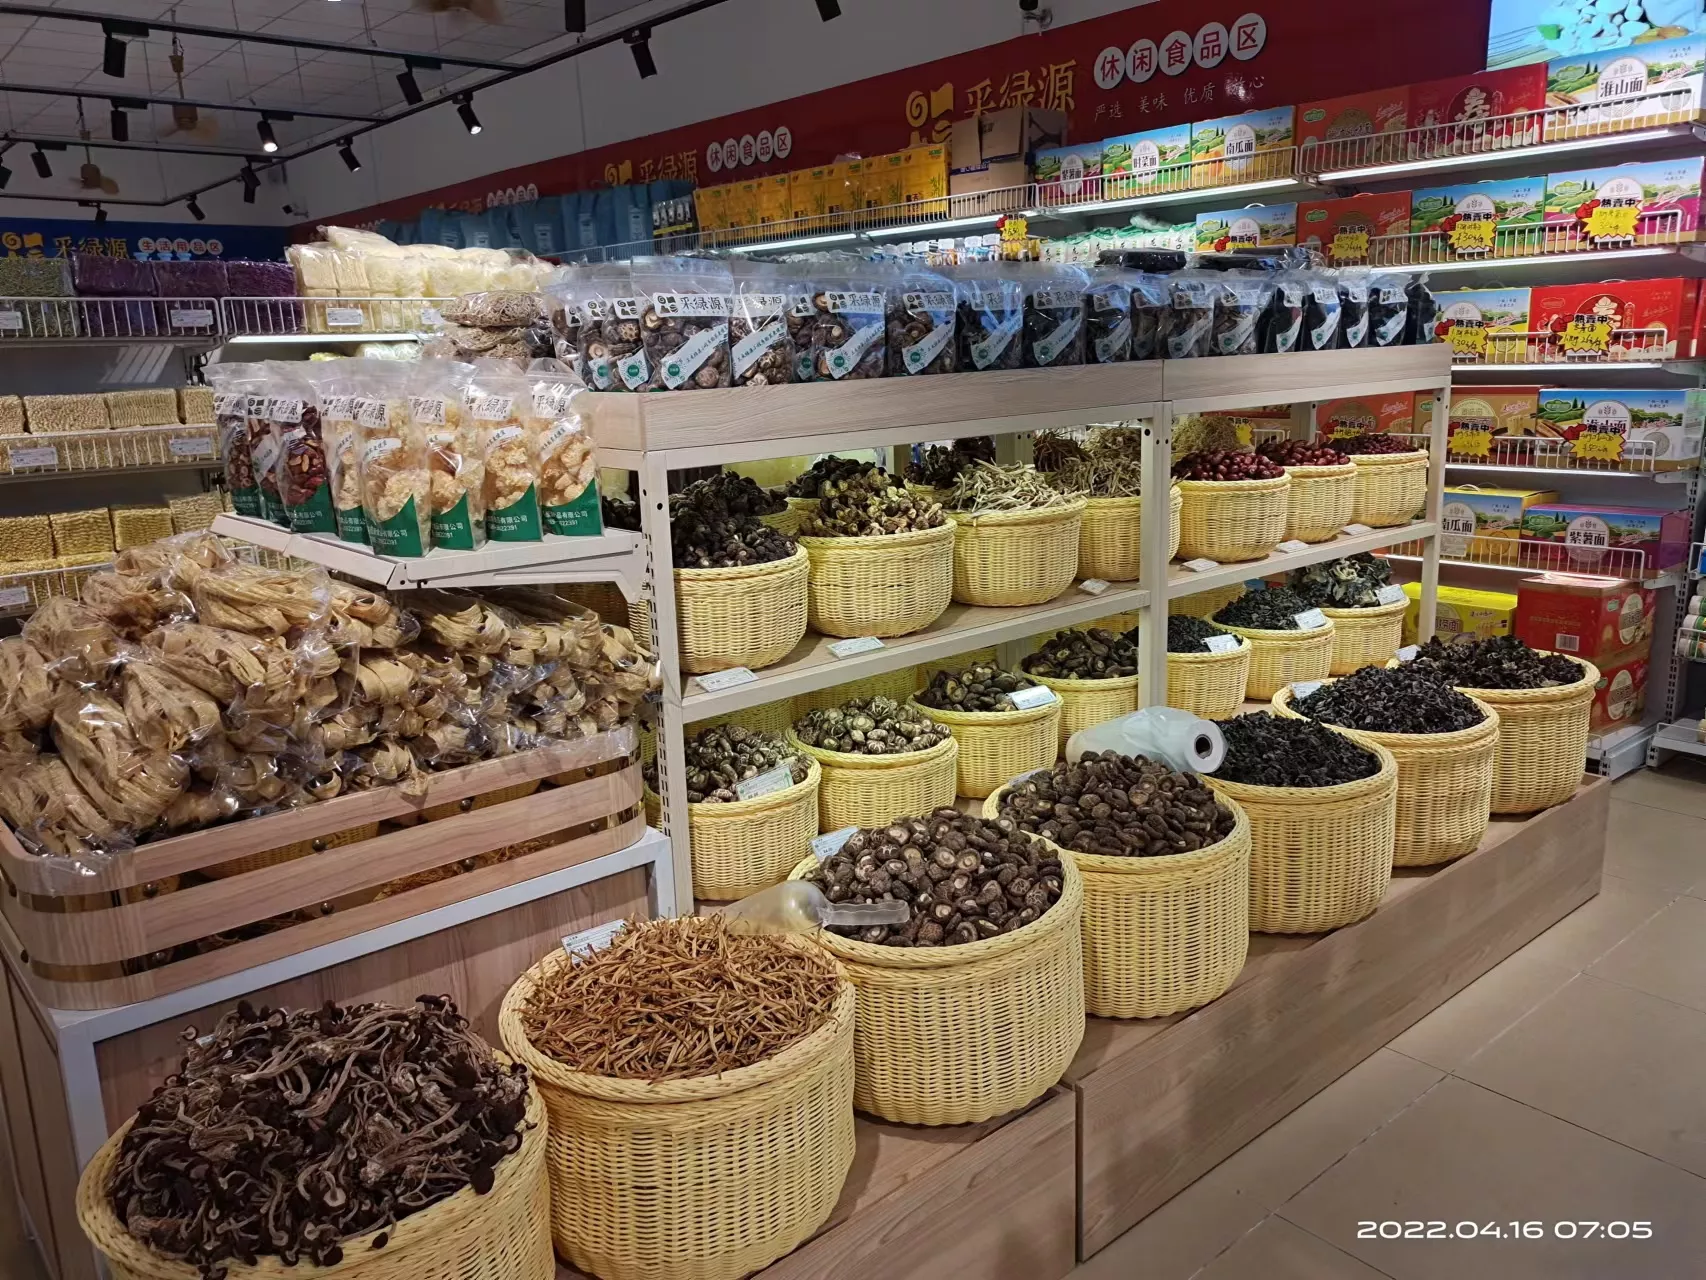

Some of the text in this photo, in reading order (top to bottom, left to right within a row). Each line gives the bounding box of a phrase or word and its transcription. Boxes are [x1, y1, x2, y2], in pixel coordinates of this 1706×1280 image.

[1100, 21, 1259, 80] 休闲食品区
[964, 60, 1077, 116] 采绿源
[1600, 77, 1644, 98] 淮山面
[1094, 104, 1124, 122] 严选
[1138, 93, 1169, 113] 美味
[1184, 82, 1216, 105] 优质
[709, 131, 789, 167] 休闲食品区
[1226, 139, 1254, 155] 南瓜面
[53, 237, 130, 259] 采绿源
[141, 238, 220, 254] 生活用品区
[680, 296, 724, 310] 采绿源
[1569, 531, 1606, 546] 紫薯面
